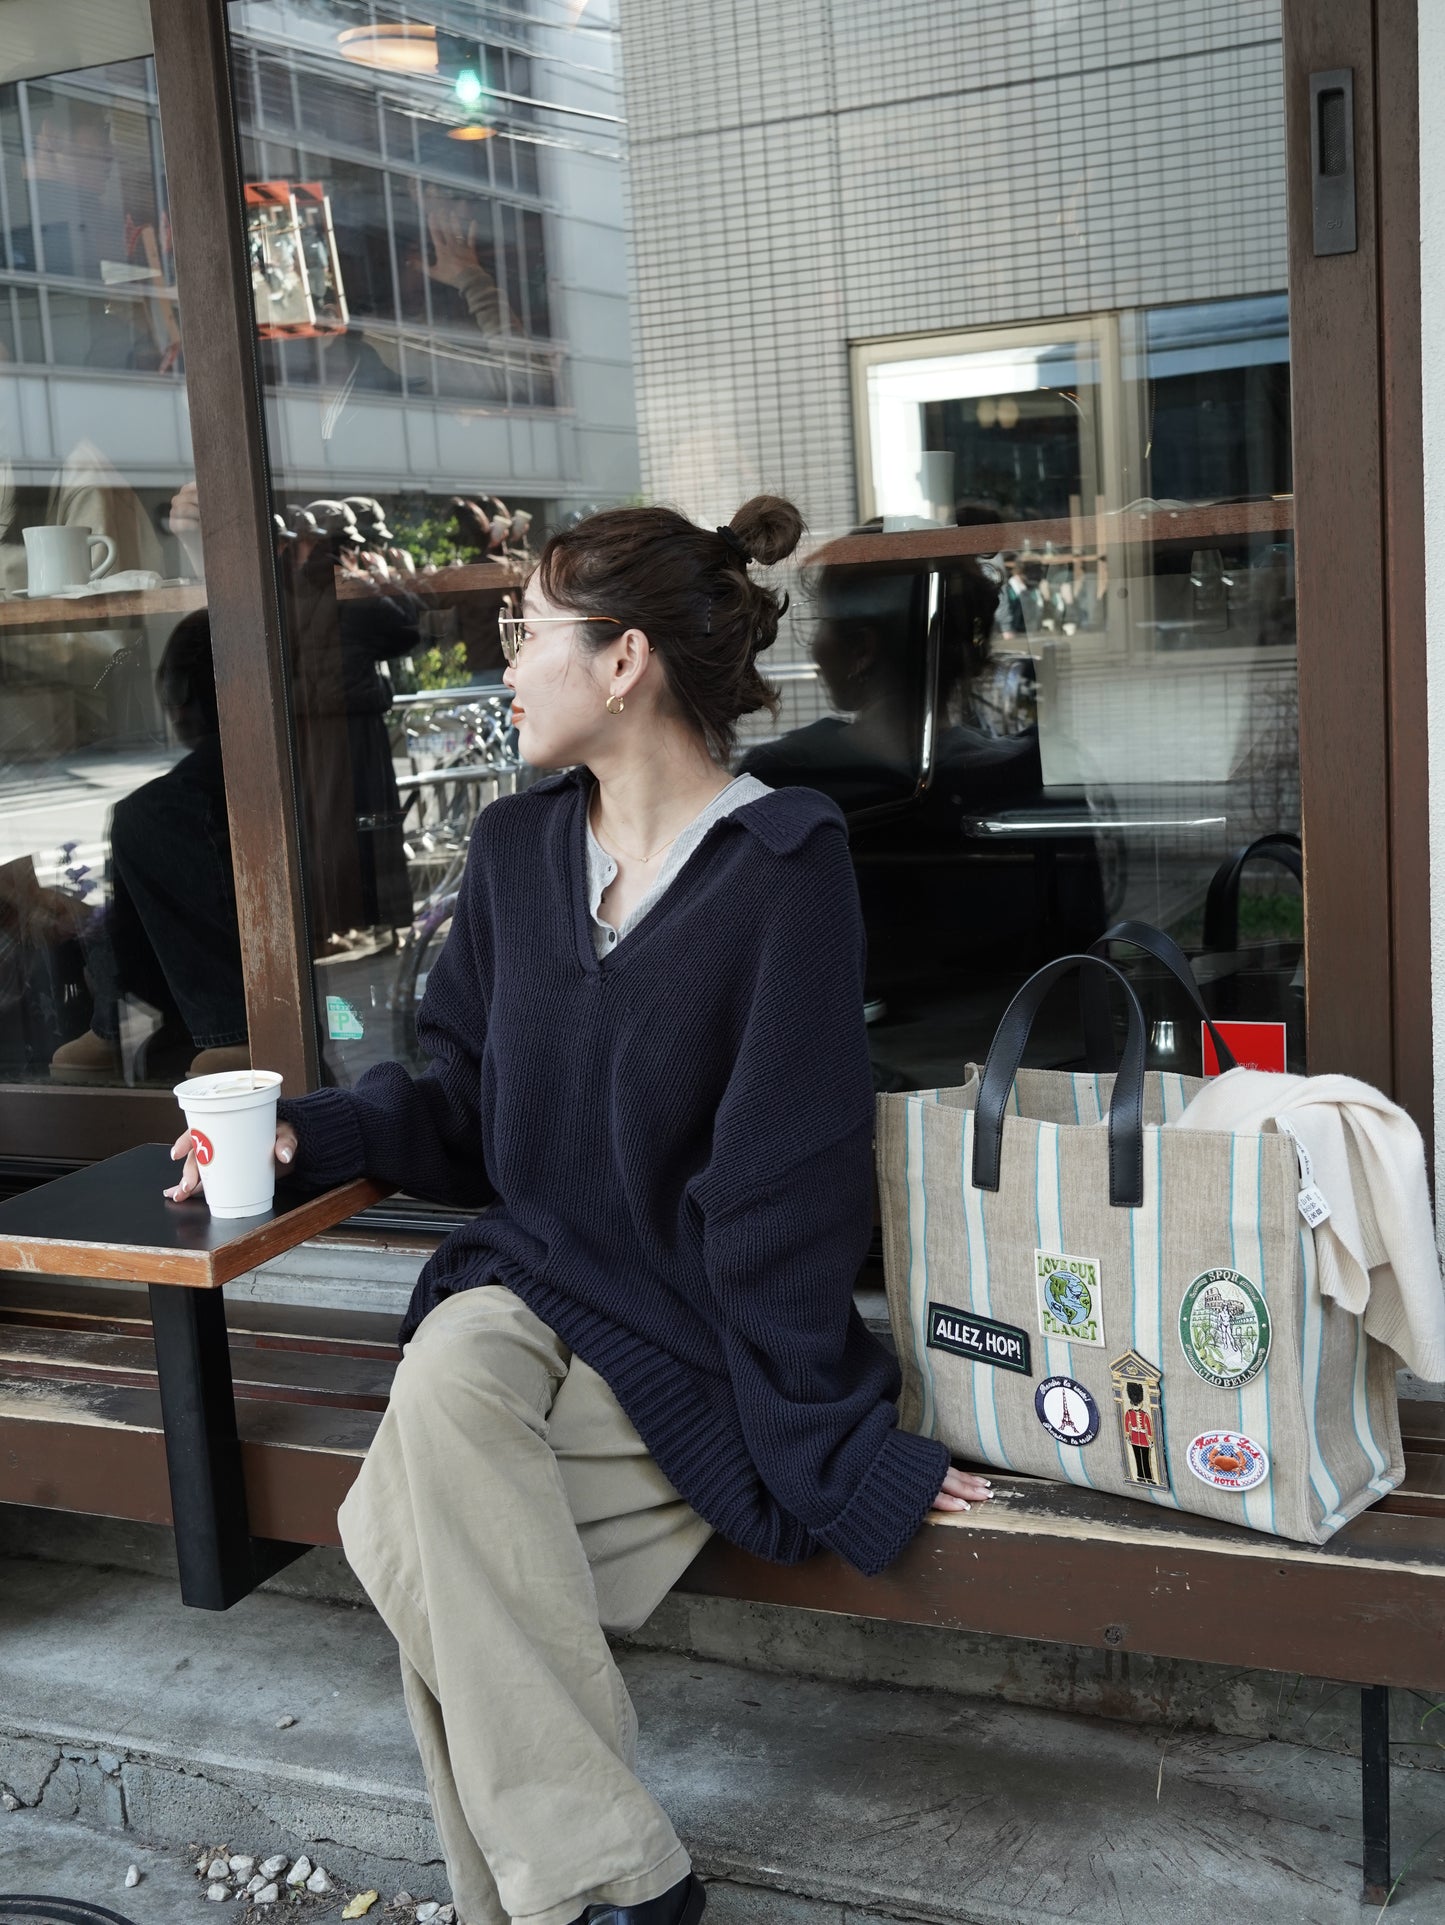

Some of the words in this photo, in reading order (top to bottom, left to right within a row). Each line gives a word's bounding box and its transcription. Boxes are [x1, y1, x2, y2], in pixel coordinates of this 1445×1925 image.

[1037, 1255, 1068, 1276] LOVE
[1069, 1262, 1097, 1286] OUR
[1207, 1270, 1239, 1282] SPQR
[1042, 1310, 1097, 1340] PLANET
[935, 1318, 983, 1351] ALLEZ,
[985, 1331, 1021, 1360] HOP!
[1198, 1367, 1222, 1386] CIAO
[1223, 1369, 1256, 1387] BELLA
[1195, 1434, 1219, 1449] Hand
[1213, 1476, 1241, 1486] HOTEL
